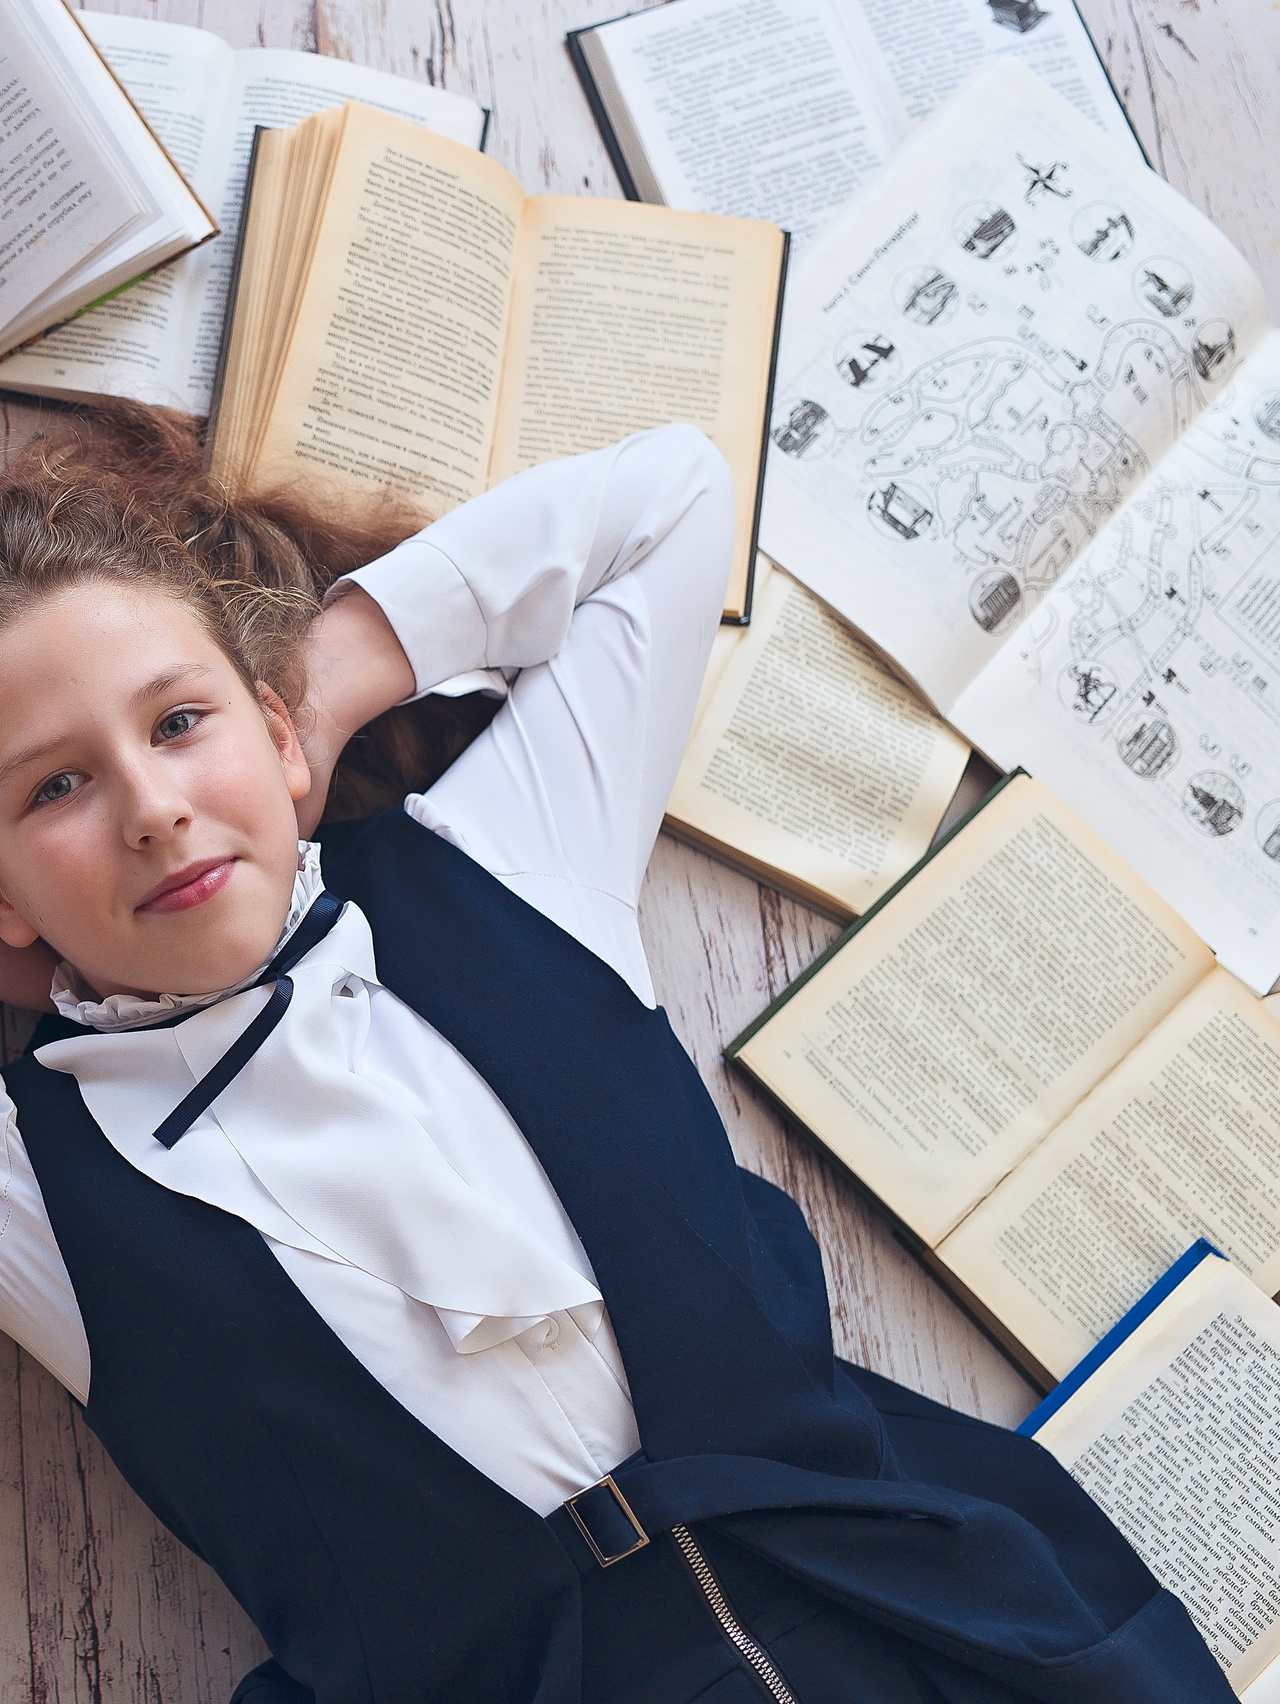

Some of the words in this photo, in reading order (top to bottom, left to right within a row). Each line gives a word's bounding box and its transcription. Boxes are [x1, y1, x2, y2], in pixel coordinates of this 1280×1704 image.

[1181, 1346, 1209, 1374] Целый
[1210, 1376, 1229, 1393] день
[1233, 1396, 1265, 1426] провели
[1209, 1319, 1248, 1357] большими
[1216, 1312, 1243, 1339] Братья
[1245, 1340, 1266, 1361] опять
[1154, 1376, 1191, 1410] вернуться
[1193, 1412, 1204, 1423] не
[1204, 1424, 1235, 1451] раньше
[1237, 1451, 1272, 1486] будущего
[1168, 1362, 1189, 1384] вновь
[1193, 1385, 1225, 1416] приняли
[1229, 1417, 1279, 1464] человеческий
[1121, 1412, 1138, 1429] тебя
[1141, 1431, 1152, 1443] на
[1154, 1444, 1185, 1474] крыльях
[1189, 1475, 1210, 1496] через
[1212, 1497, 1238, 1520] море?
[1087, 1447, 1117, 1477] тившись
[1122, 1480, 1133, 1492] на
[1137, 1495, 1167, 1523] восходе
[1171, 1526, 1198, 1553] солнца
[1212, 1565, 1245, 1598] лебедей,
[1249, 1599, 1274, 1625] братья
[1116, 1515, 1147, 1545] светили
[1149, 1546, 1161, 1557] ей
[1162, 1558, 1187, 1583] прямо
[1198, 1593, 1219, 1615] лицо,
[1222, 1615, 1254, 1647] поэтому
[1209, 1643, 1233, 1669] Элиза
